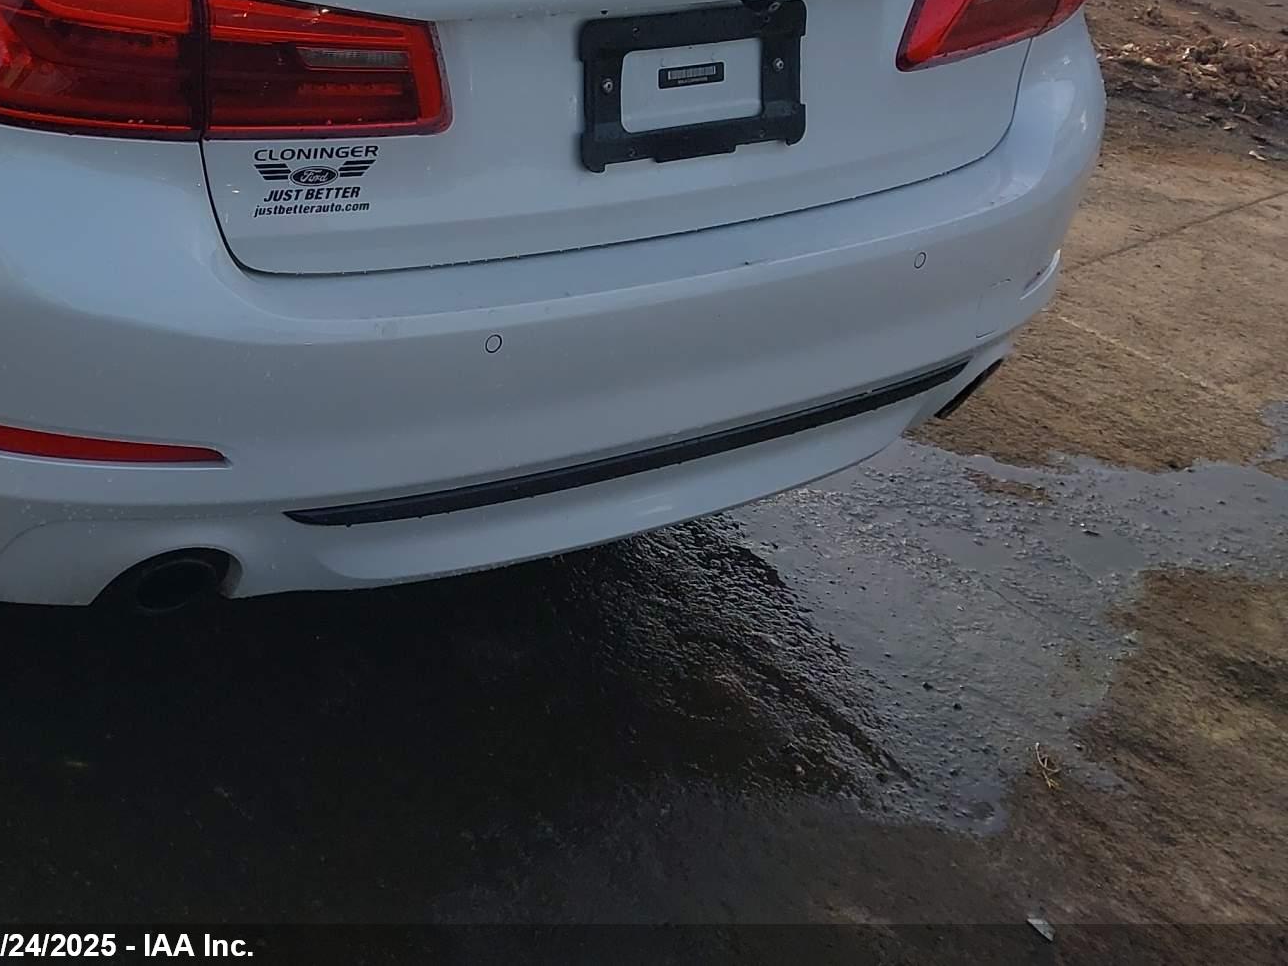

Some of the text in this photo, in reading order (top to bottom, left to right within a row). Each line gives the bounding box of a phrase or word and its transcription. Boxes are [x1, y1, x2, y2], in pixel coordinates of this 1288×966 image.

[254, 145, 379, 161] CLONINGER
[300, 169, 329, 183] Ford
[264, 186, 361, 202] JUST BETTER
[254, 202, 370, 218] justbetterauto.com
